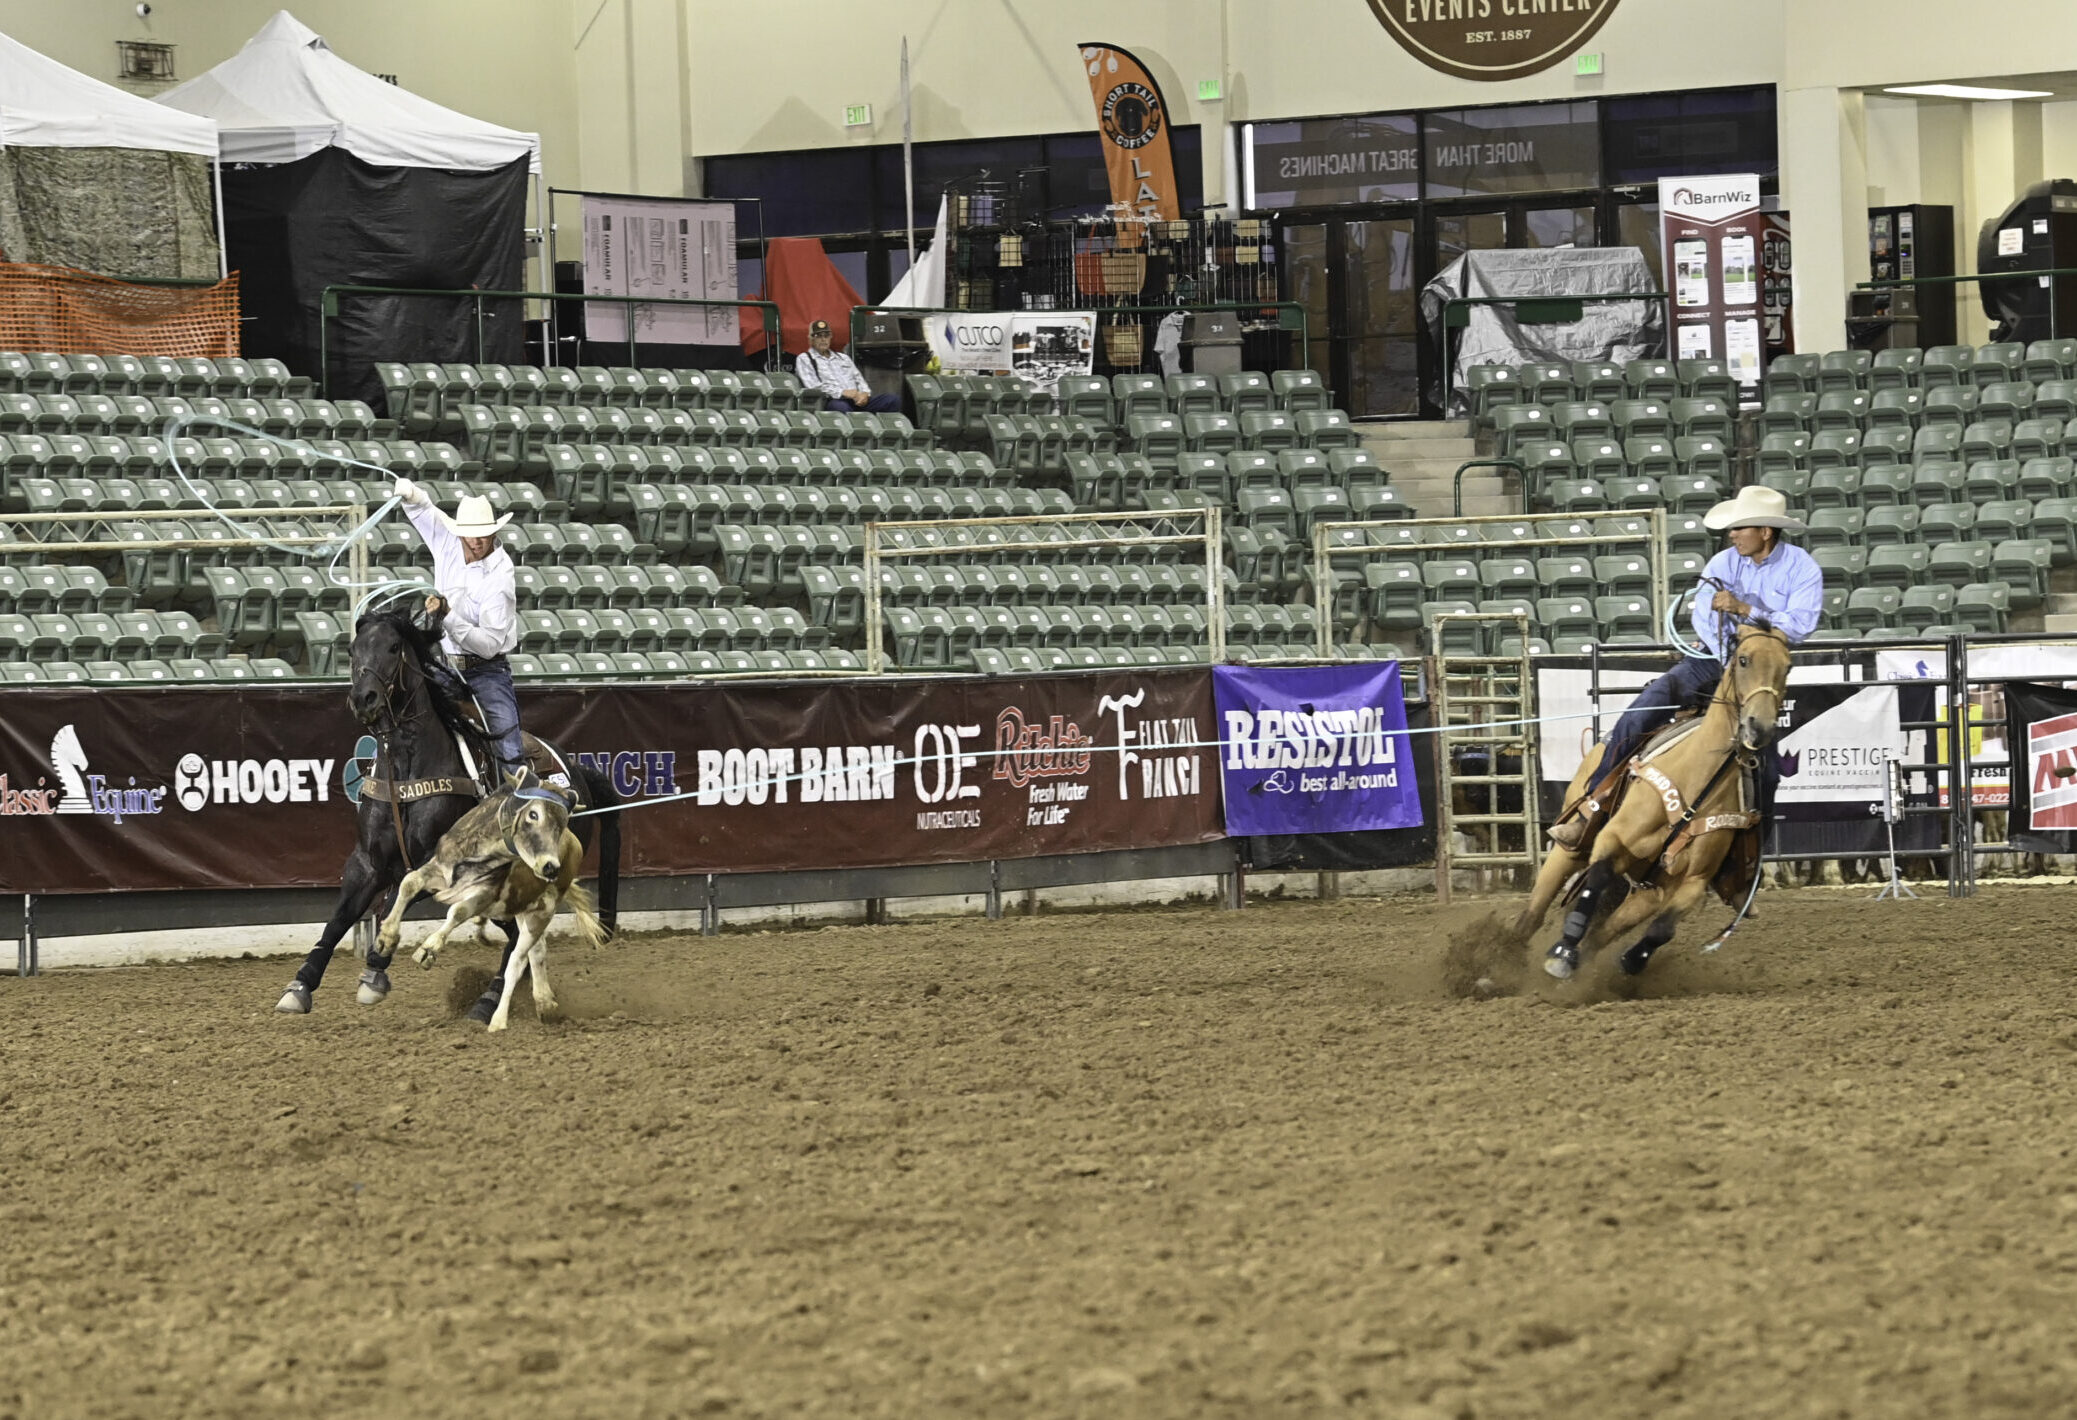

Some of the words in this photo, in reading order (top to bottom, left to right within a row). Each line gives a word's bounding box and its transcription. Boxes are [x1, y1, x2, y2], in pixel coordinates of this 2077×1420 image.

[1405, 0, 1491, 23] EVENTS
[1465, 31, 1498, 44] EST.
[1500, 29, 1532, 41] 1887
[1103, 84, 1129, 117] SHORT
[1134, 85, 1157, 107] TAIL
[847, 105, 866, 124] EXIT
[1115, 128, 1156, 149] COFFEE
[1694, 191, 1751, 205] BarnWiz
[956, 325, 1004, 346] CUTCO
[992, 705, 1092, 788] Ritchie
[1224, 706, 1396, 771] RESISTOL
[212, 758, 335, 804] HOOEY
[697, 748, 795, 806] BOOT
[800, 745, 895, 803] BARN
[1300, 772, 1328, 793] best
[1330, 767, 1398, 791] all-around
[1808, 769, 1842, 777] EQUINE
[87, 774, 163, 825] Equine
[399, 778, 453, 799] SADDLES
[1028, 782, 1056, 804] Fresh
[1056, 781, 1090, 802] Water
[916, 809, 981, 830] NUTRACEUTICALS
[1026, 806, 1044, 826] For
